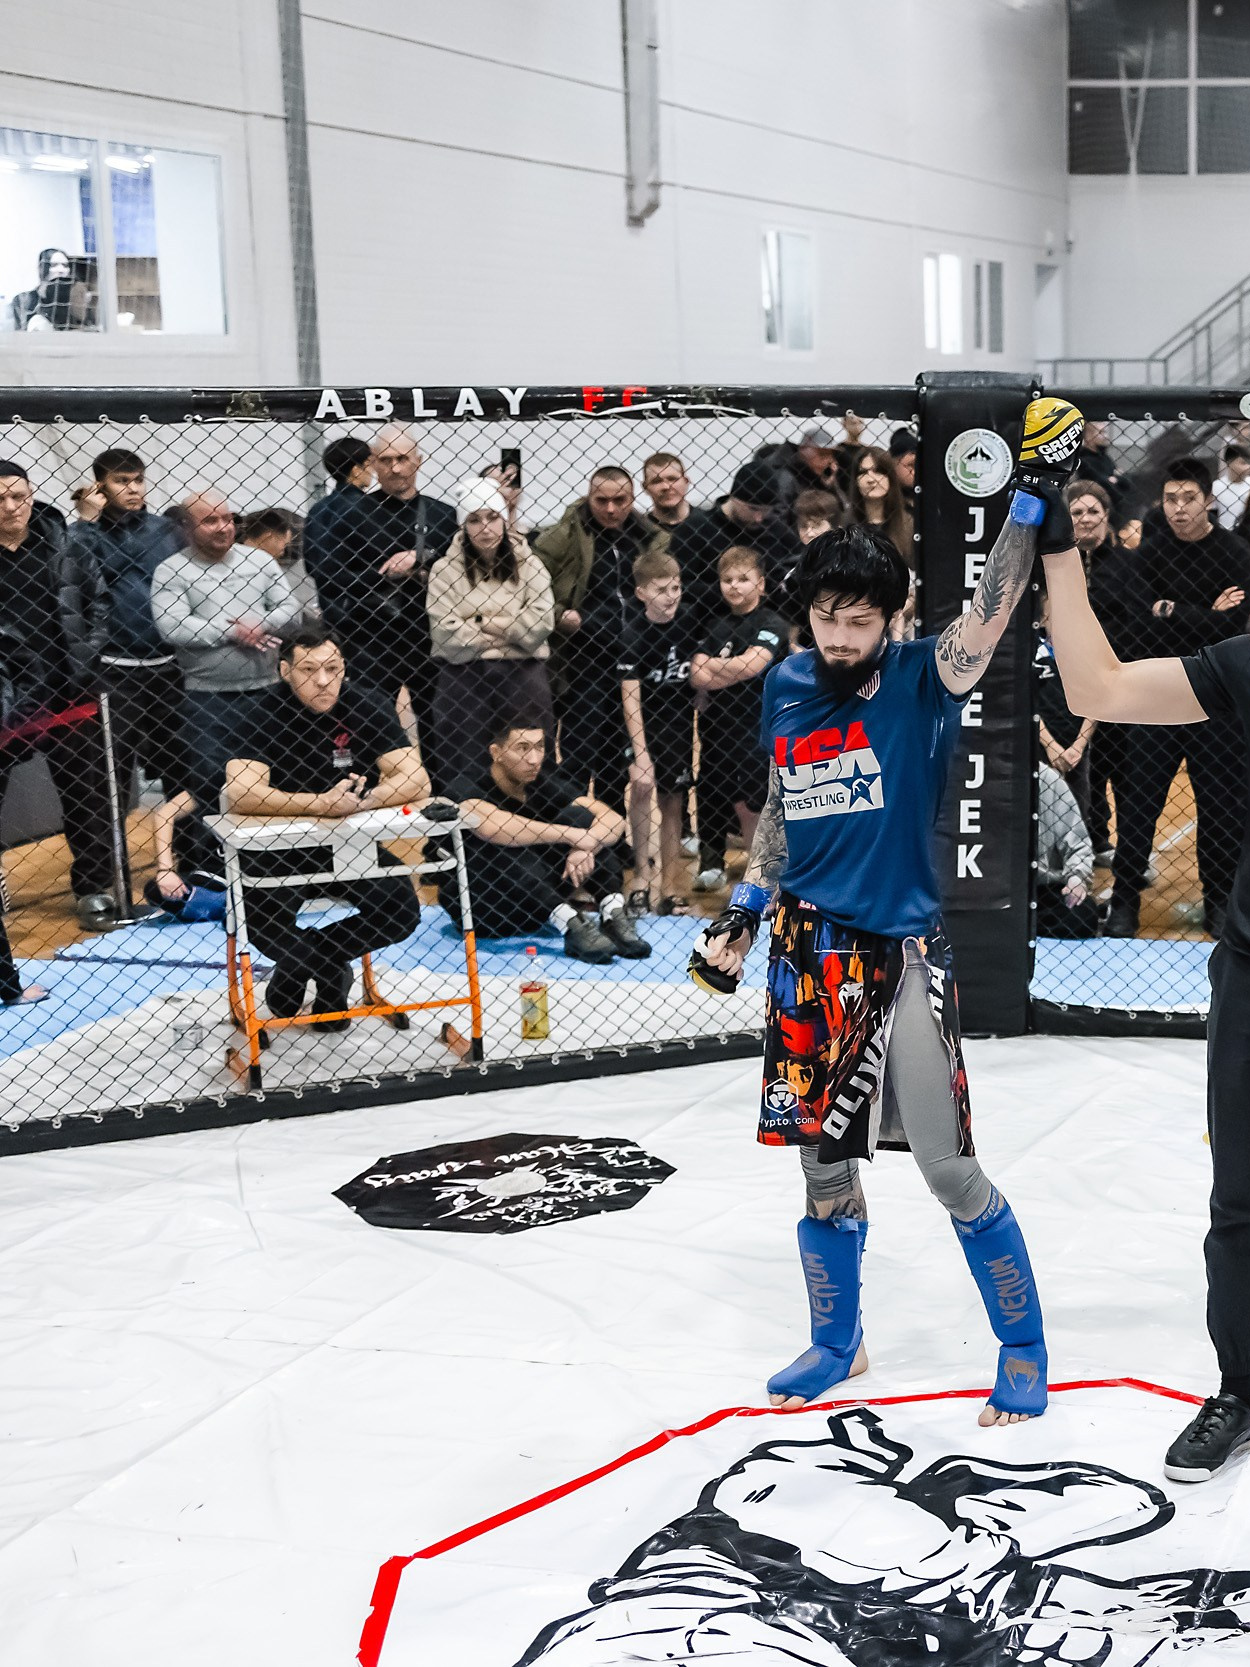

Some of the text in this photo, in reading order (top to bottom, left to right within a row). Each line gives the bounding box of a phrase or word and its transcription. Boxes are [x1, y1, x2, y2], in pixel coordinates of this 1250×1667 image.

[313, 387, 529, 419] ABLAY
[1038, 421, 1084, 455] GREEN
[1042, 439, 1081, 464] HILL
[960, 507, 987, 728] JEE
[775, 721, 881, 792] USA
[786, 791, 845, 811] WRESTLING
[956, 753, 986, 879] JEK
[759, 1117, 815, 1128] rypto.com
[801, 1252, 841, 1328] VENUM
[988, 1254, 1029, 1326] VENUM
